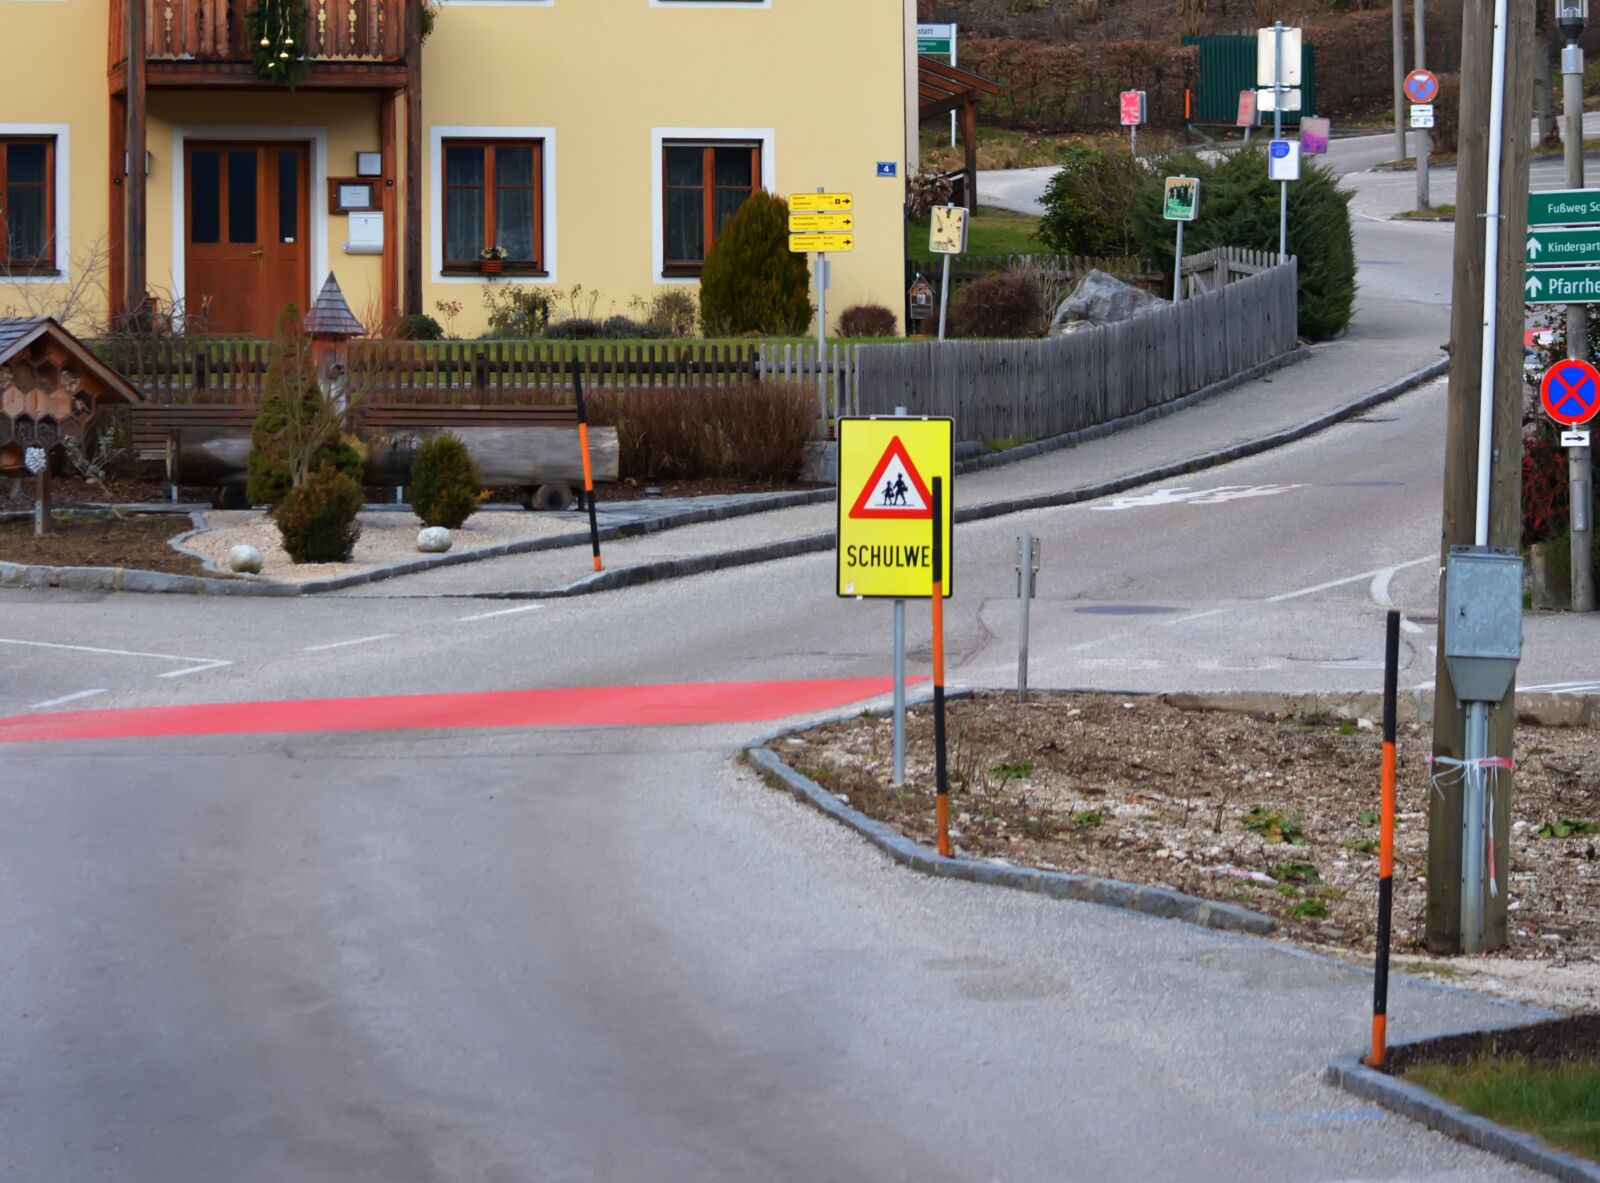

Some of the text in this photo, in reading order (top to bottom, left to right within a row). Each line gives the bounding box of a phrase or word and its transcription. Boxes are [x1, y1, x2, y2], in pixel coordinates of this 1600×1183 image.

[1548, 203, 1587, 214] Fußweg
[1549, 277, 1600, 294] Pfarrhe
[847, 545, 934, 567] SCHULWE
